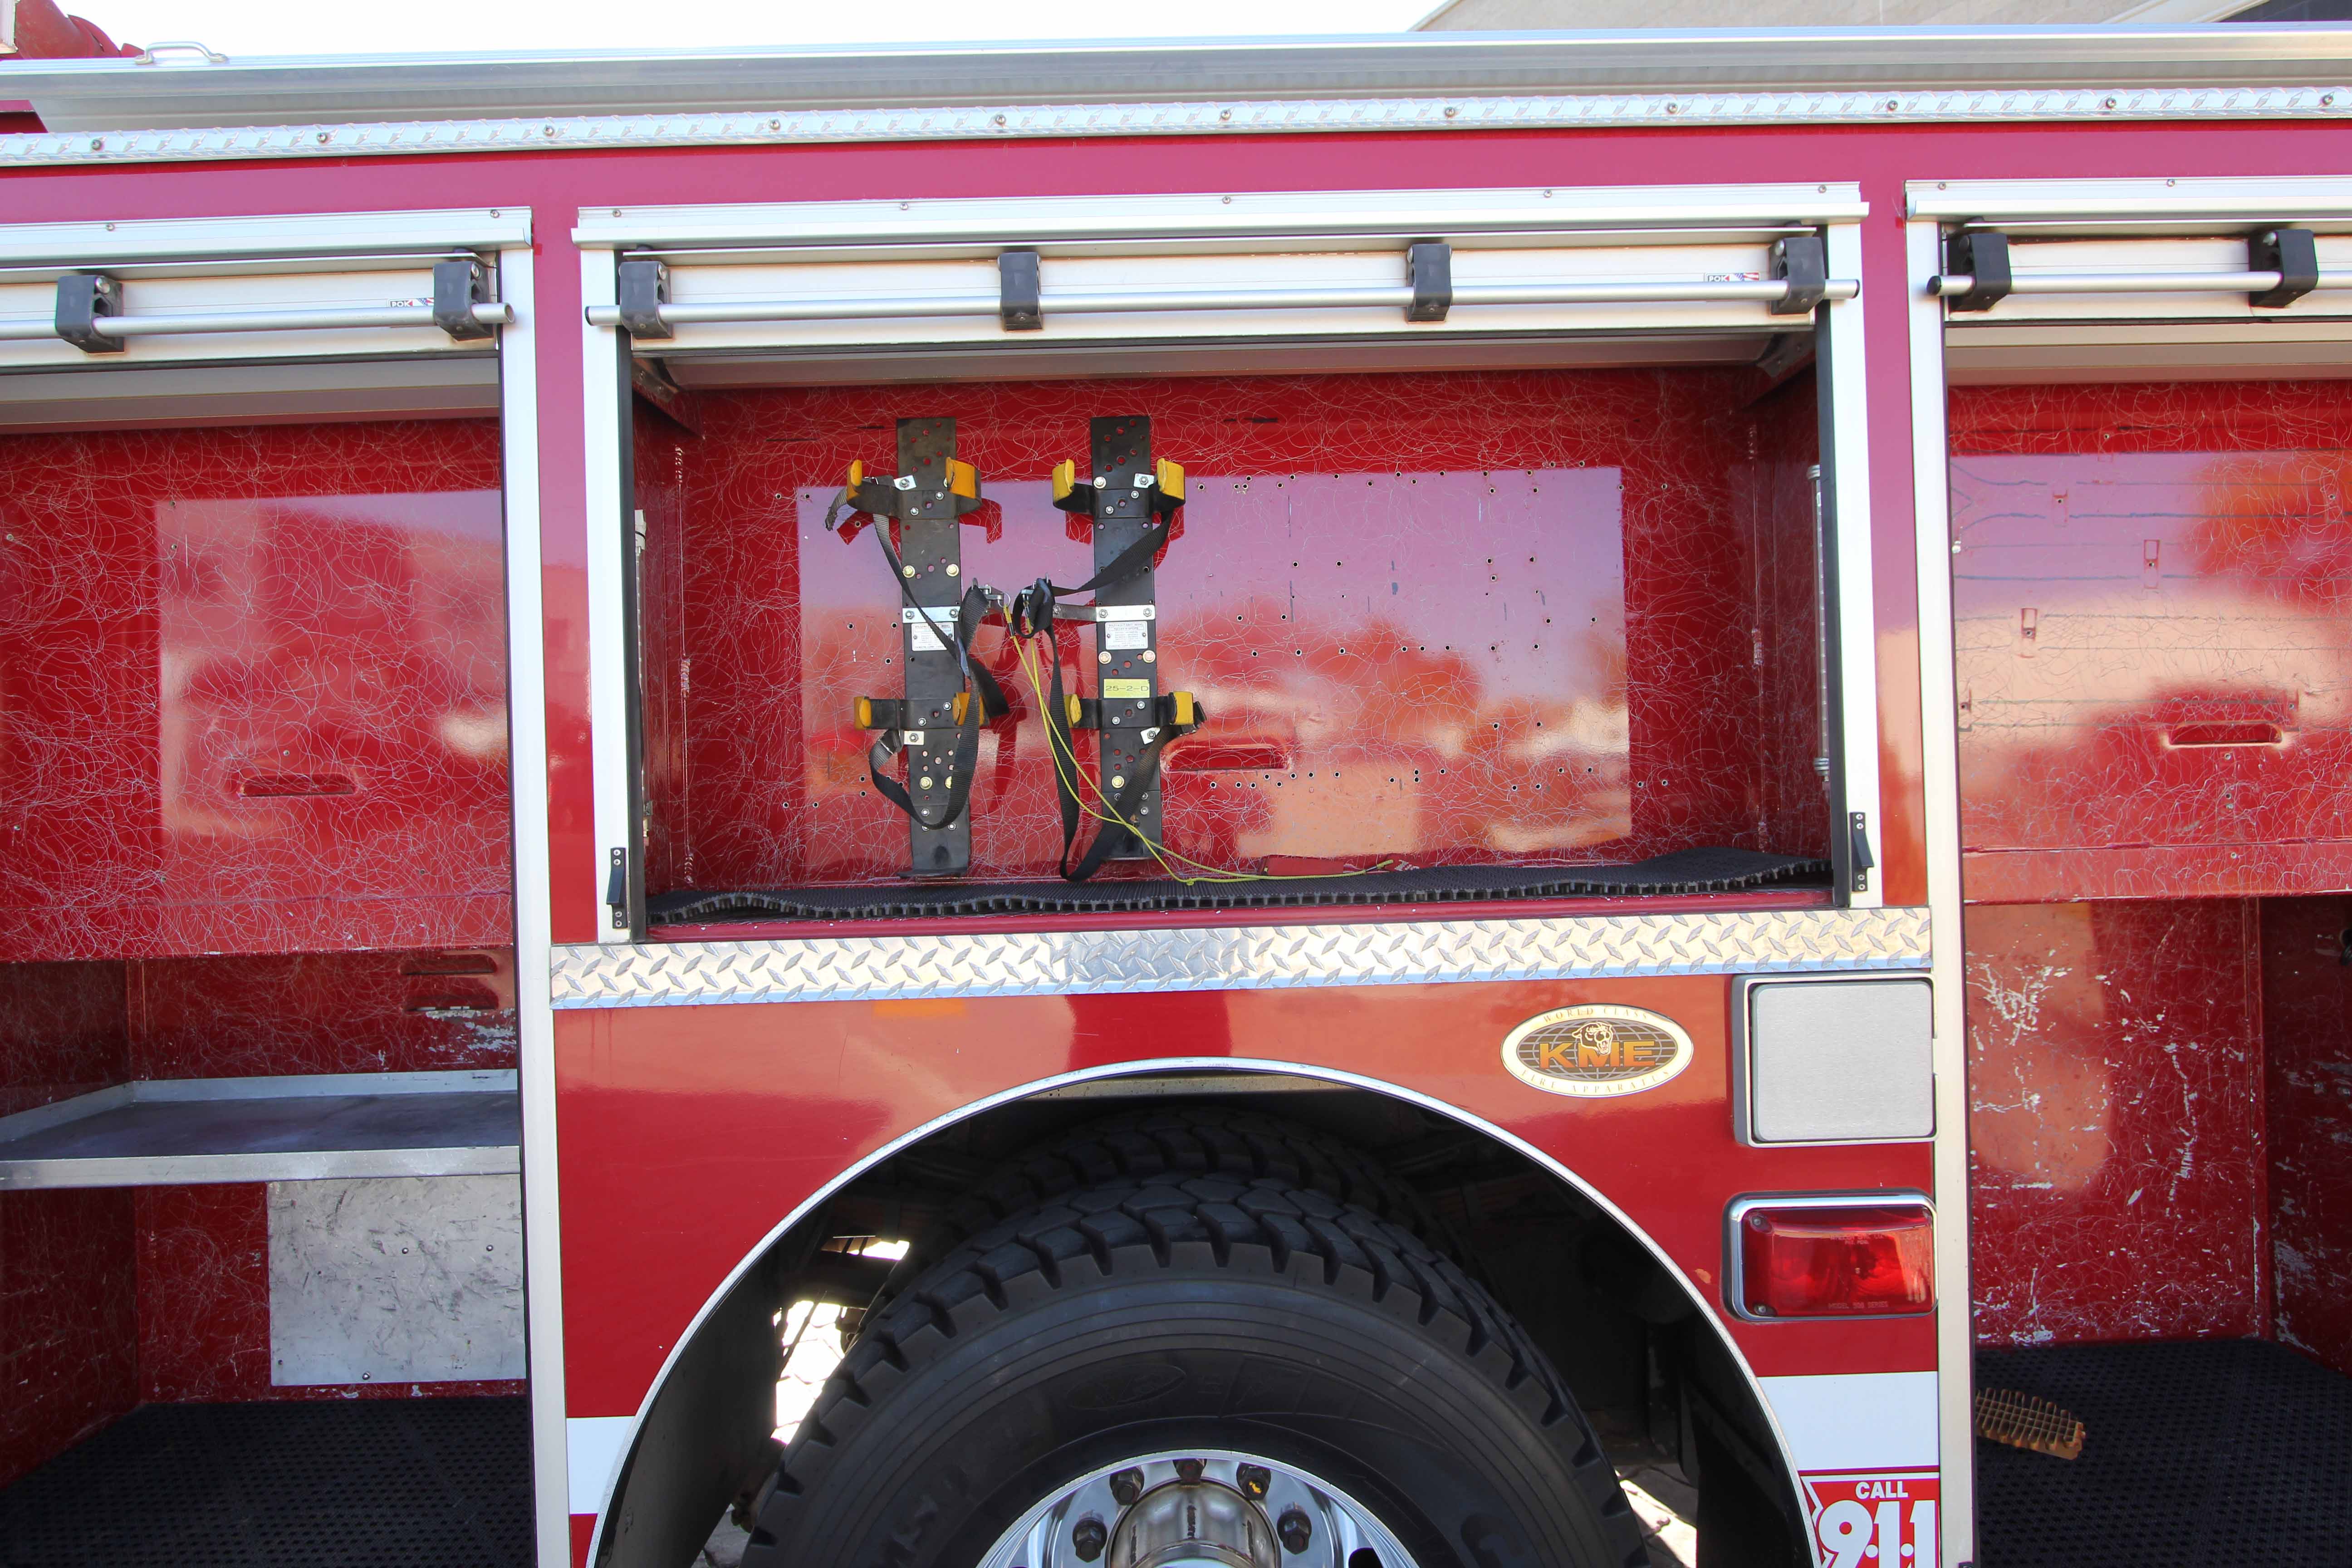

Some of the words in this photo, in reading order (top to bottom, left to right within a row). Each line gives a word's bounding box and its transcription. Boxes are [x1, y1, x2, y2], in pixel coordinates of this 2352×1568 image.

[1543, 1007, 1593, 1023] WORLD
[1603, 1005, 1647, 1020] CLASS
[1539, 1040, 1656, 1069] KME
[1855, 1481, 1908, 1499] CALL
